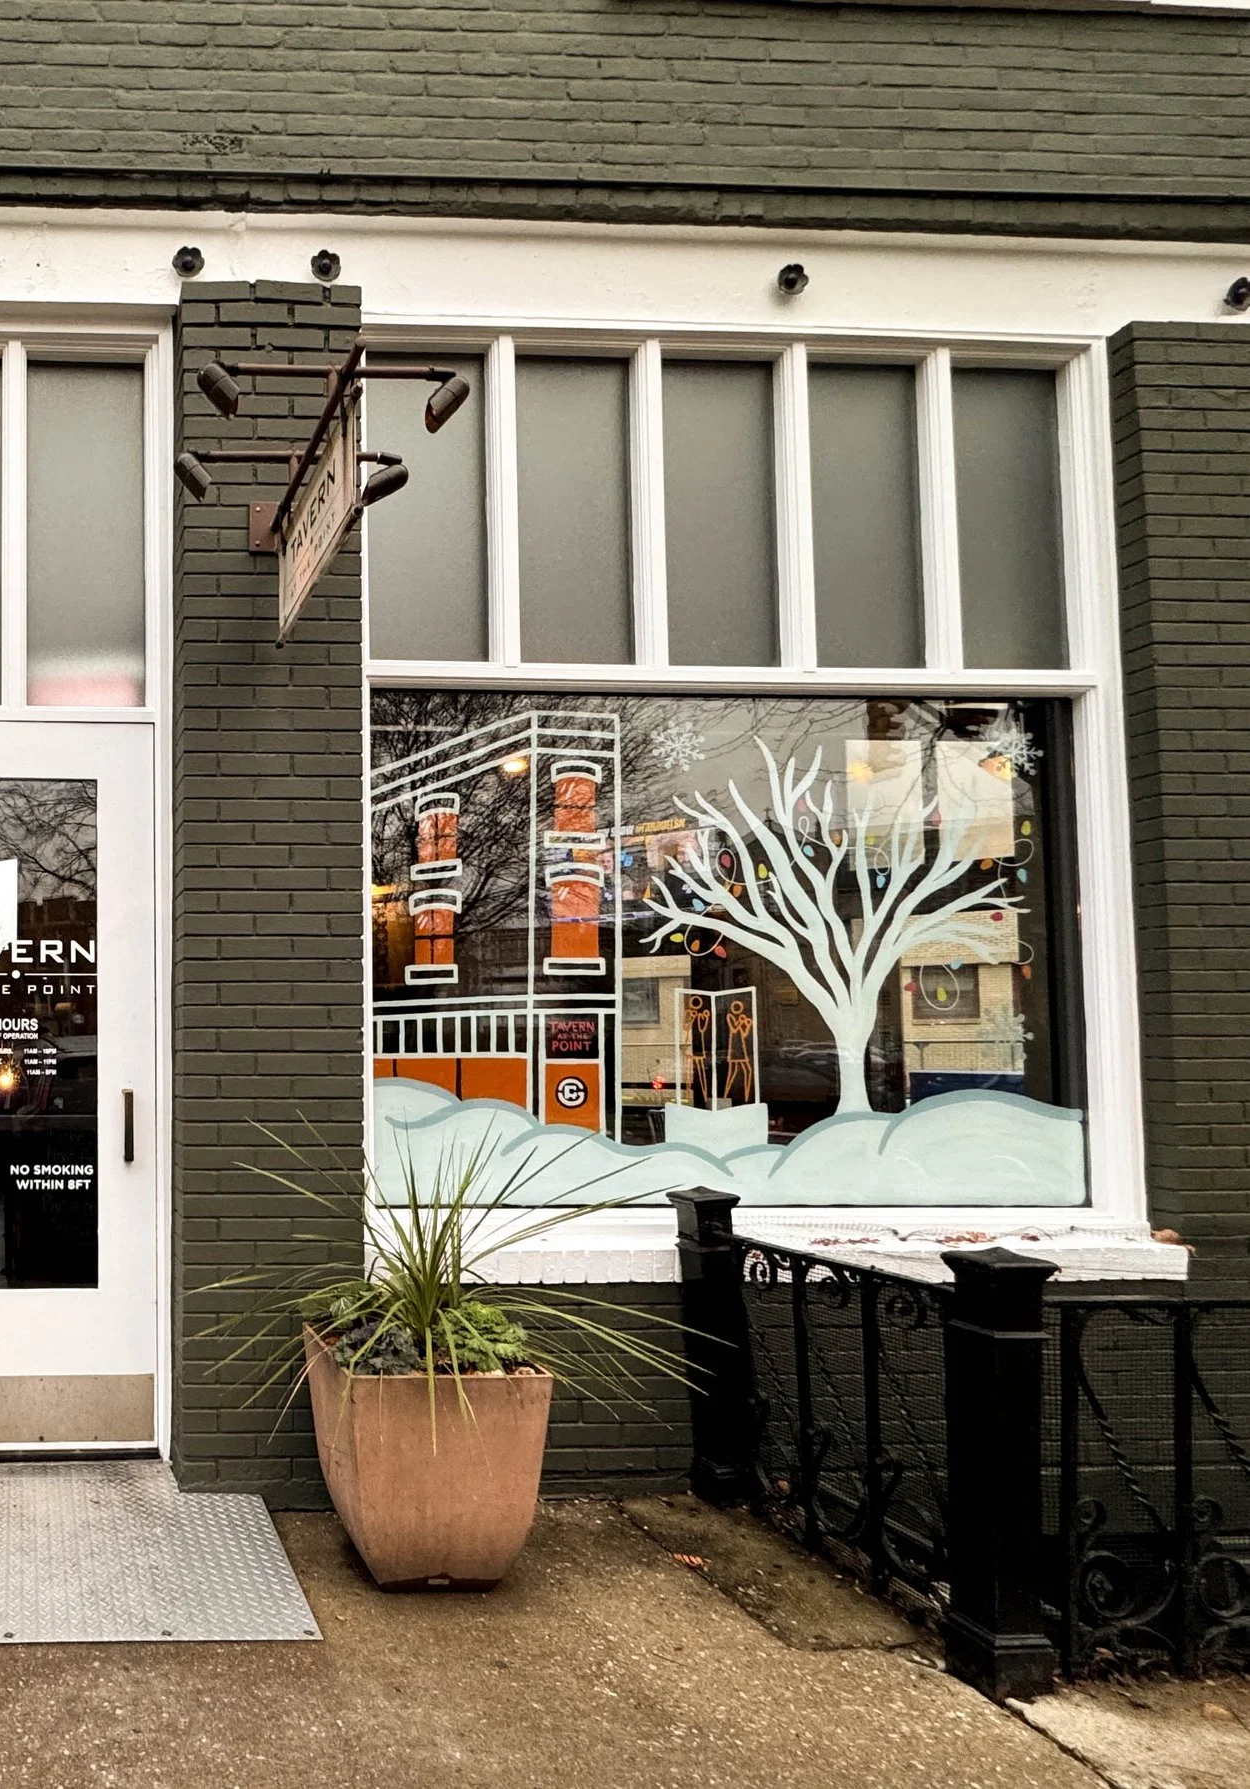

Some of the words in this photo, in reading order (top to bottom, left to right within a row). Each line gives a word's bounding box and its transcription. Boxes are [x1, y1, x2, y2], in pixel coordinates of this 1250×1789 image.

[291, 457, 336, 563] TAVERN
[314, 511, 336, 556] POINT
[27, 984, 96, 995] POINT
[547, 1020, 595, 1033] TAVERN
[551, 1041, 592, 1052] POINT
[10, 1164, 30, 1175] NO
[33, 1164, 94, 1175] SMOKING
[16, 1179, 64, 1190] WITHIN
[67, 1179, 91, 1190] 8FT
